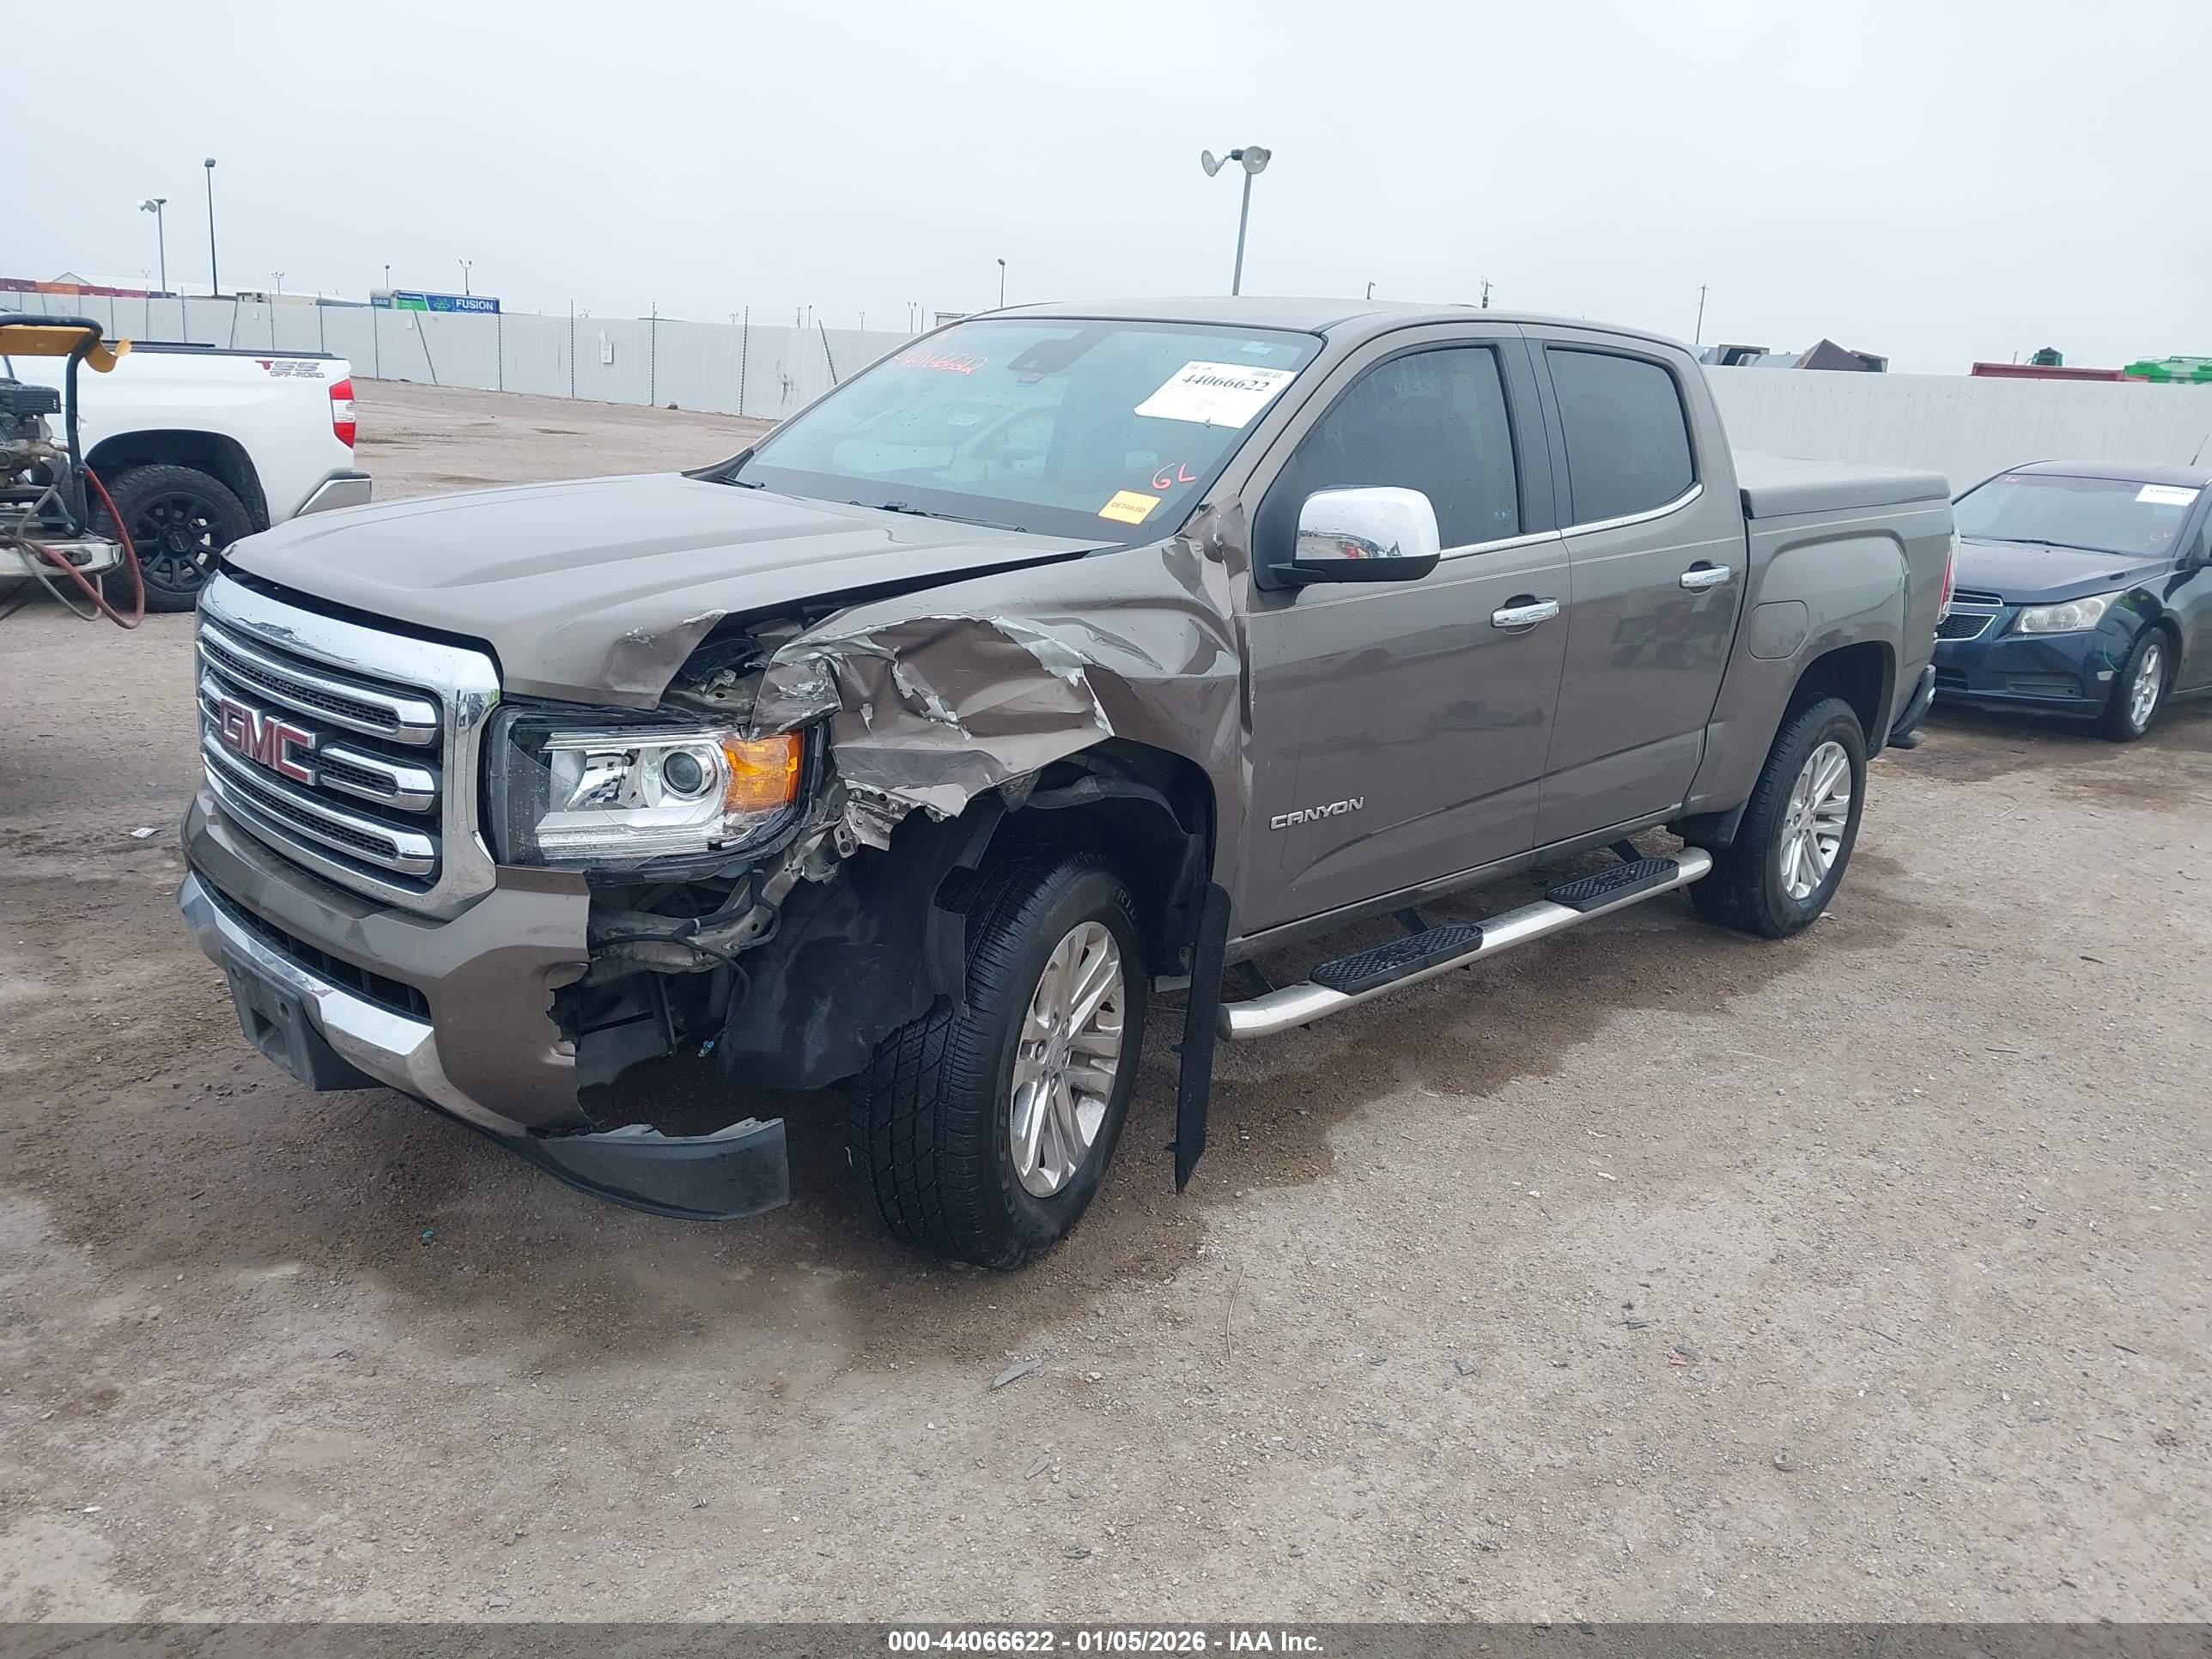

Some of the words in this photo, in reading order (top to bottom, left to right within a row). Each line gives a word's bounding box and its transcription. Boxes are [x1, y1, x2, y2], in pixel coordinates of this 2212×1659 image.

[456, 299, 494, 312] FUSION
[1182, 374, 1270, 392] 44066622
[1111, 501, 1146, 514] DETAILED
[219, 696, 316, 786] GMC
[1270, 797, 1364, 830] CANYON
